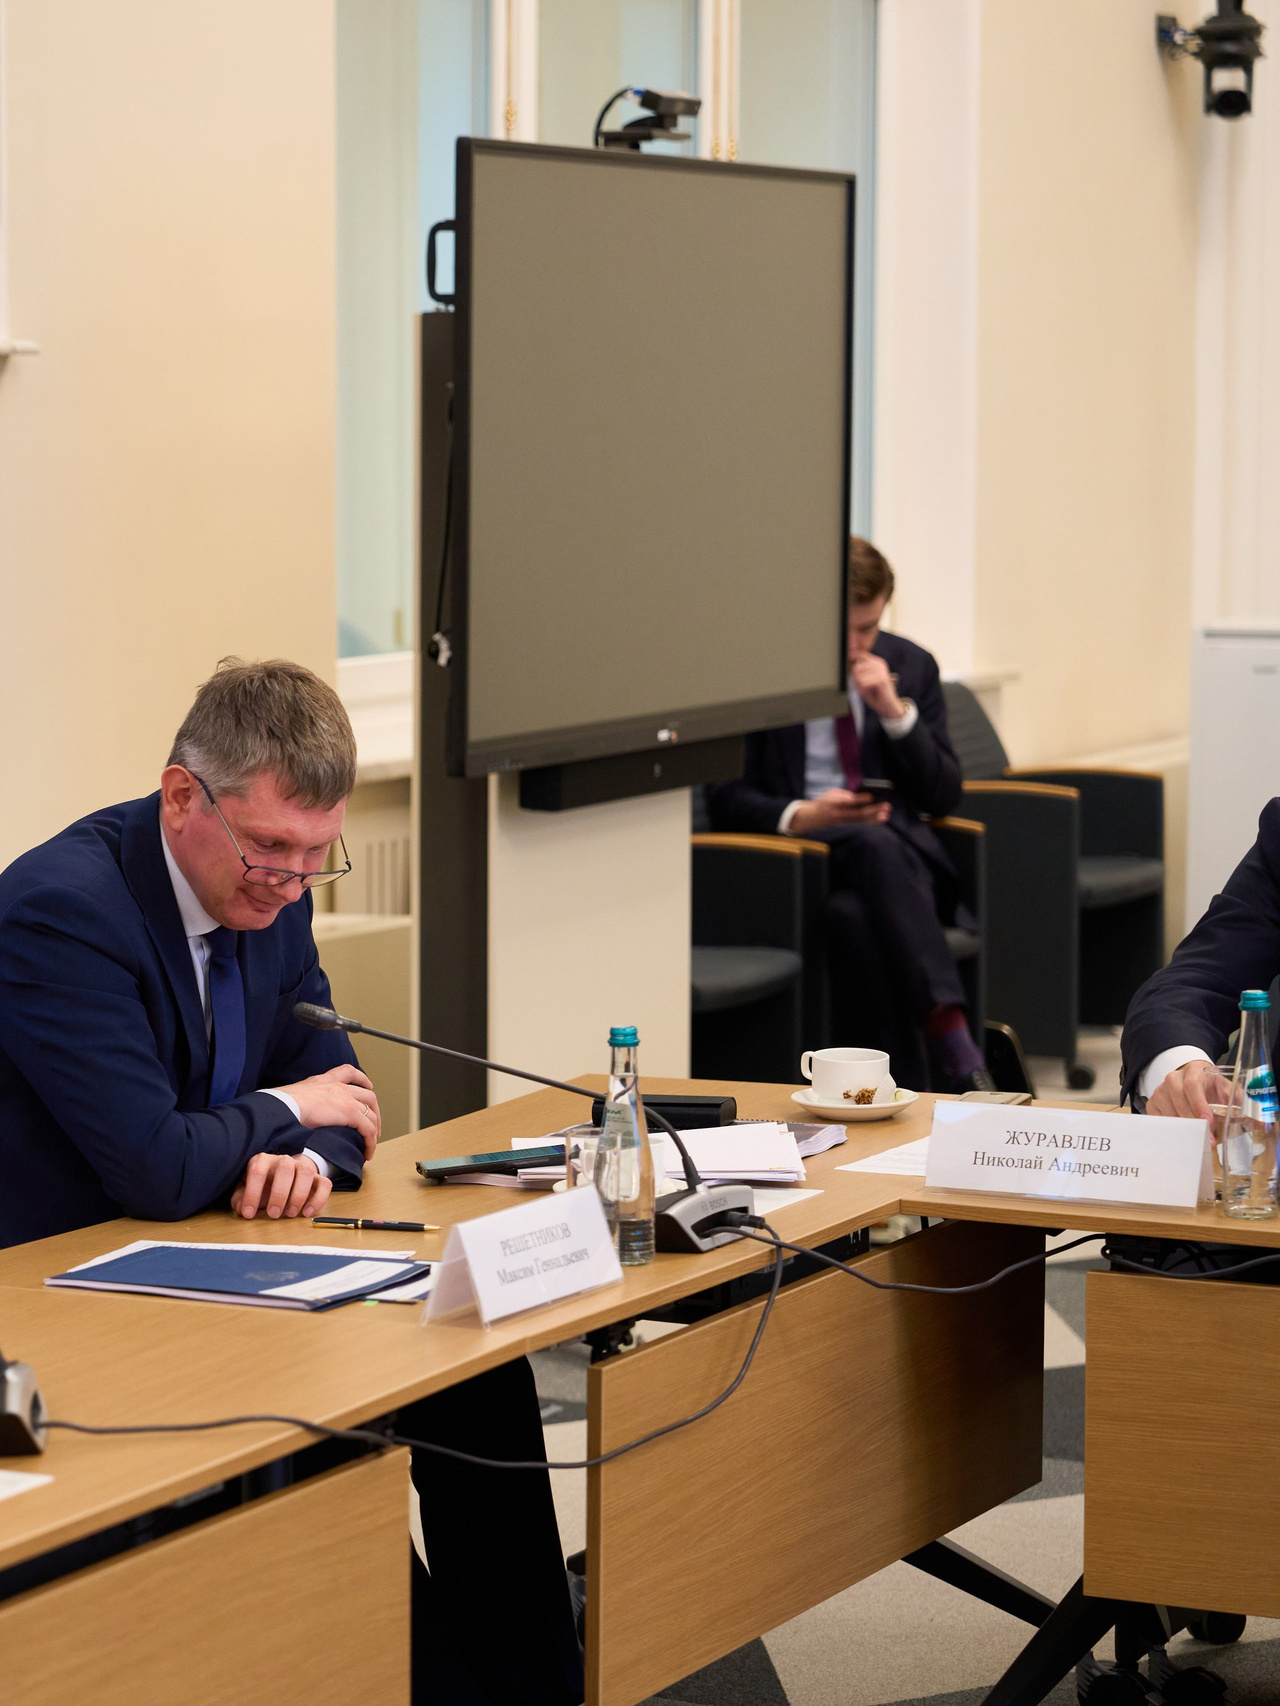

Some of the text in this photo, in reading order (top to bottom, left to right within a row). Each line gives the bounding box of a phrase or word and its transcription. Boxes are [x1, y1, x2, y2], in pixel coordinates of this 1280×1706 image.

[1005, 1130, 1111, 1152] ЖУРАВЛЕВ
[972, 1151, 1140, 1178] Николай Андреевич
[500, 1222, 572, 1257] РЕШЕТНИКОВ
[496, 1263, 535, 1286] Максим
